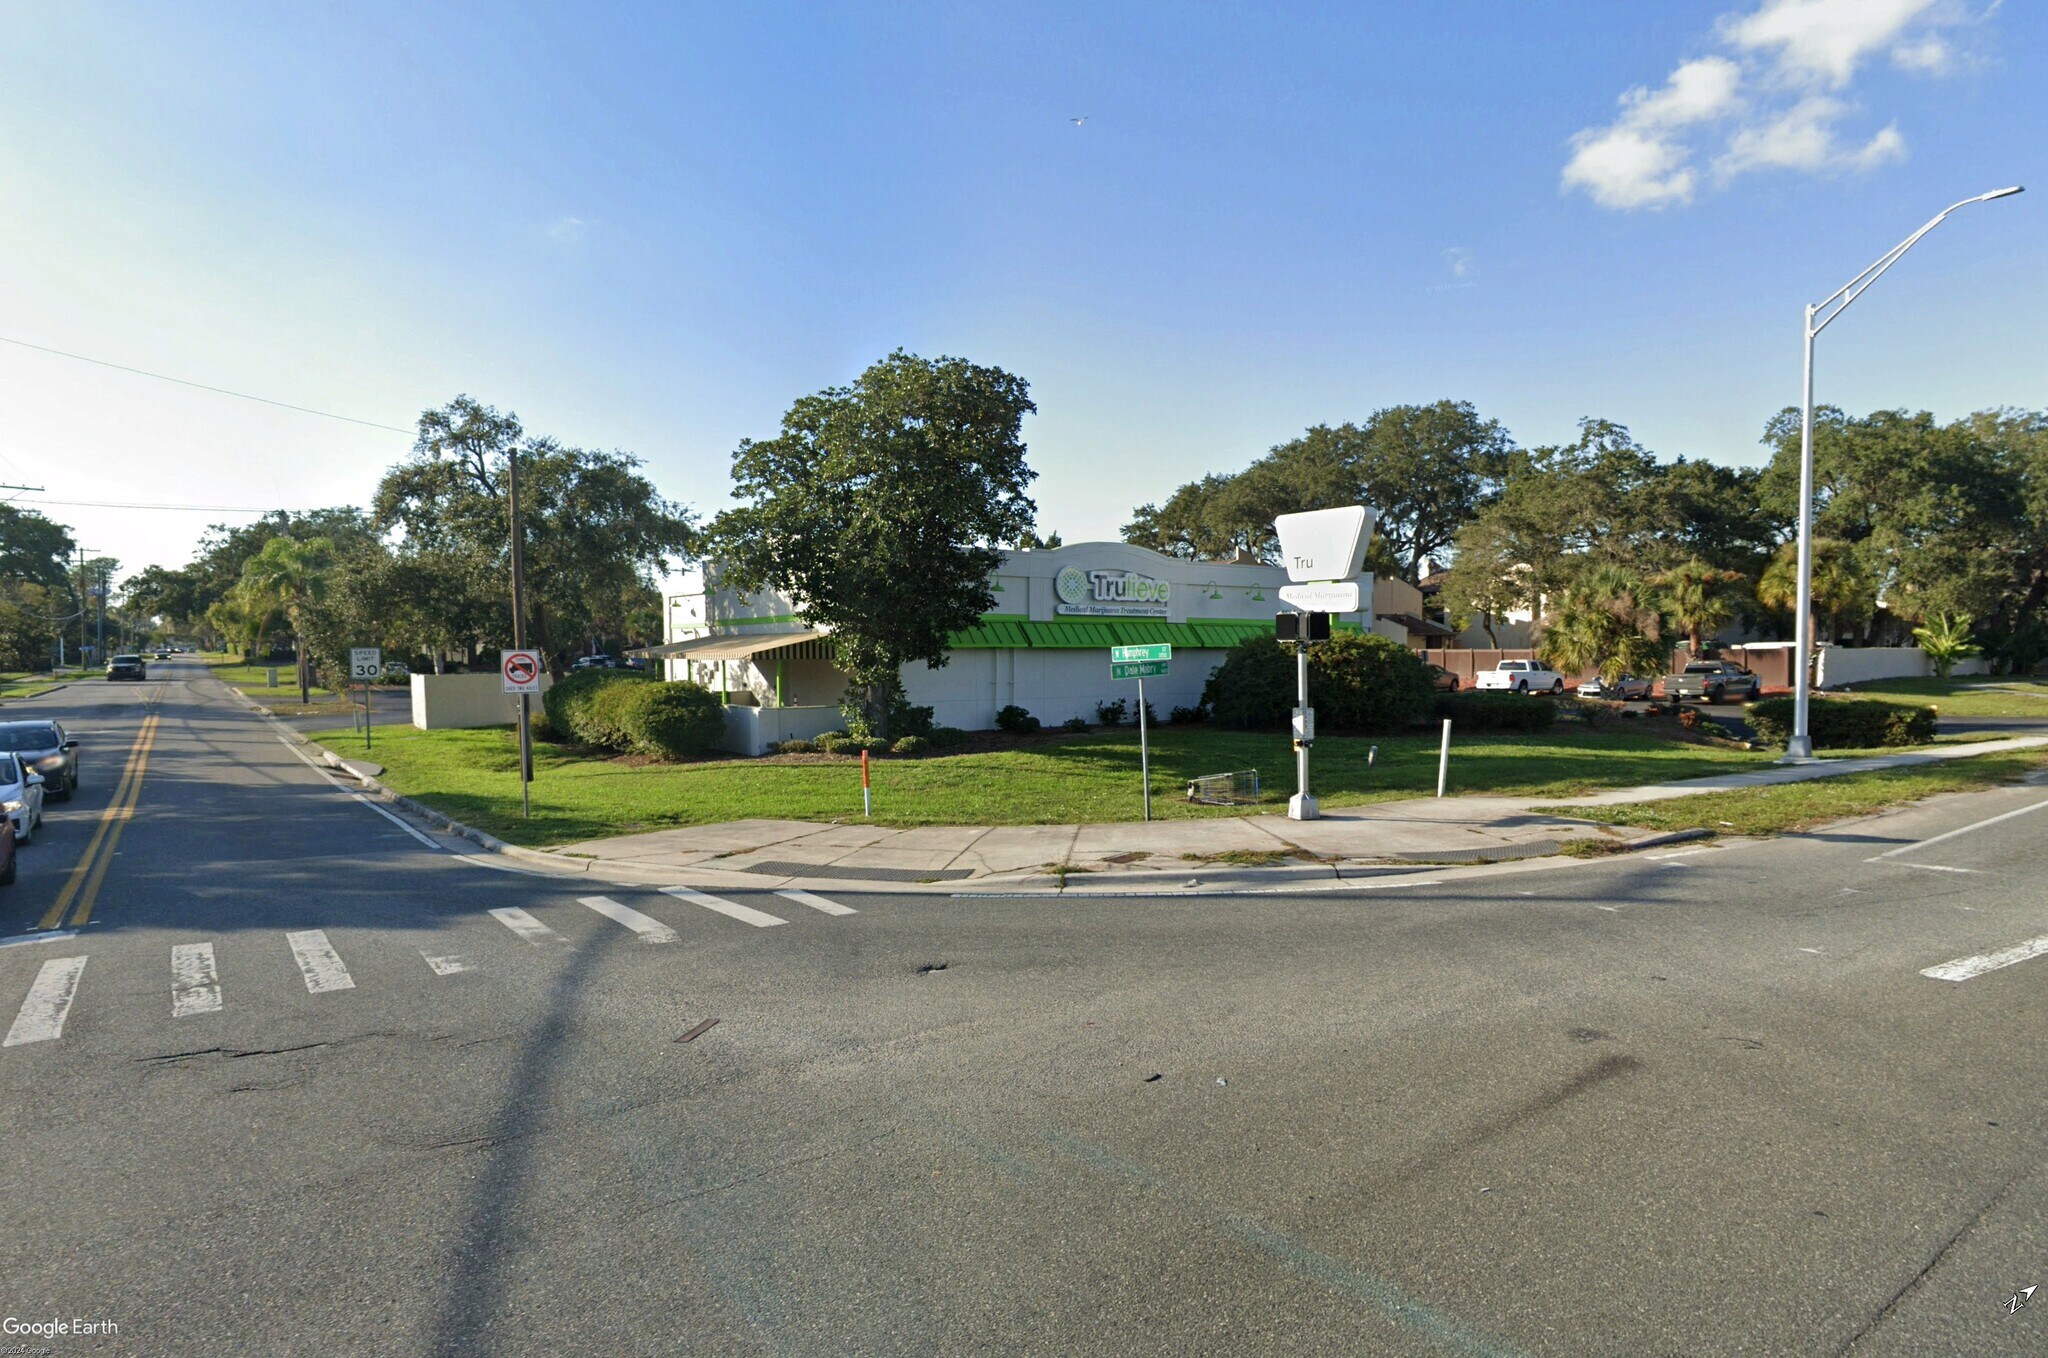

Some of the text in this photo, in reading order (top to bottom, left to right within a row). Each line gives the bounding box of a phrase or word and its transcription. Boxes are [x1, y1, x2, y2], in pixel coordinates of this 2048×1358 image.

[1294, 556, 1314, 570] Tru
[1094, 574, 1169, 599] Trulieve
[1064, 605, 1088, 613] Medical
[1089, 605, 1120, 615] Marijuana
[1120, 606, 1149, 615] Treatment
[1122, 647, 1149, 660] Humphrey
[356, 664, 378, 676] 30
[1124, 665, 1138, 676] Dale
[1139, 664, 1156, 675] Mabry
